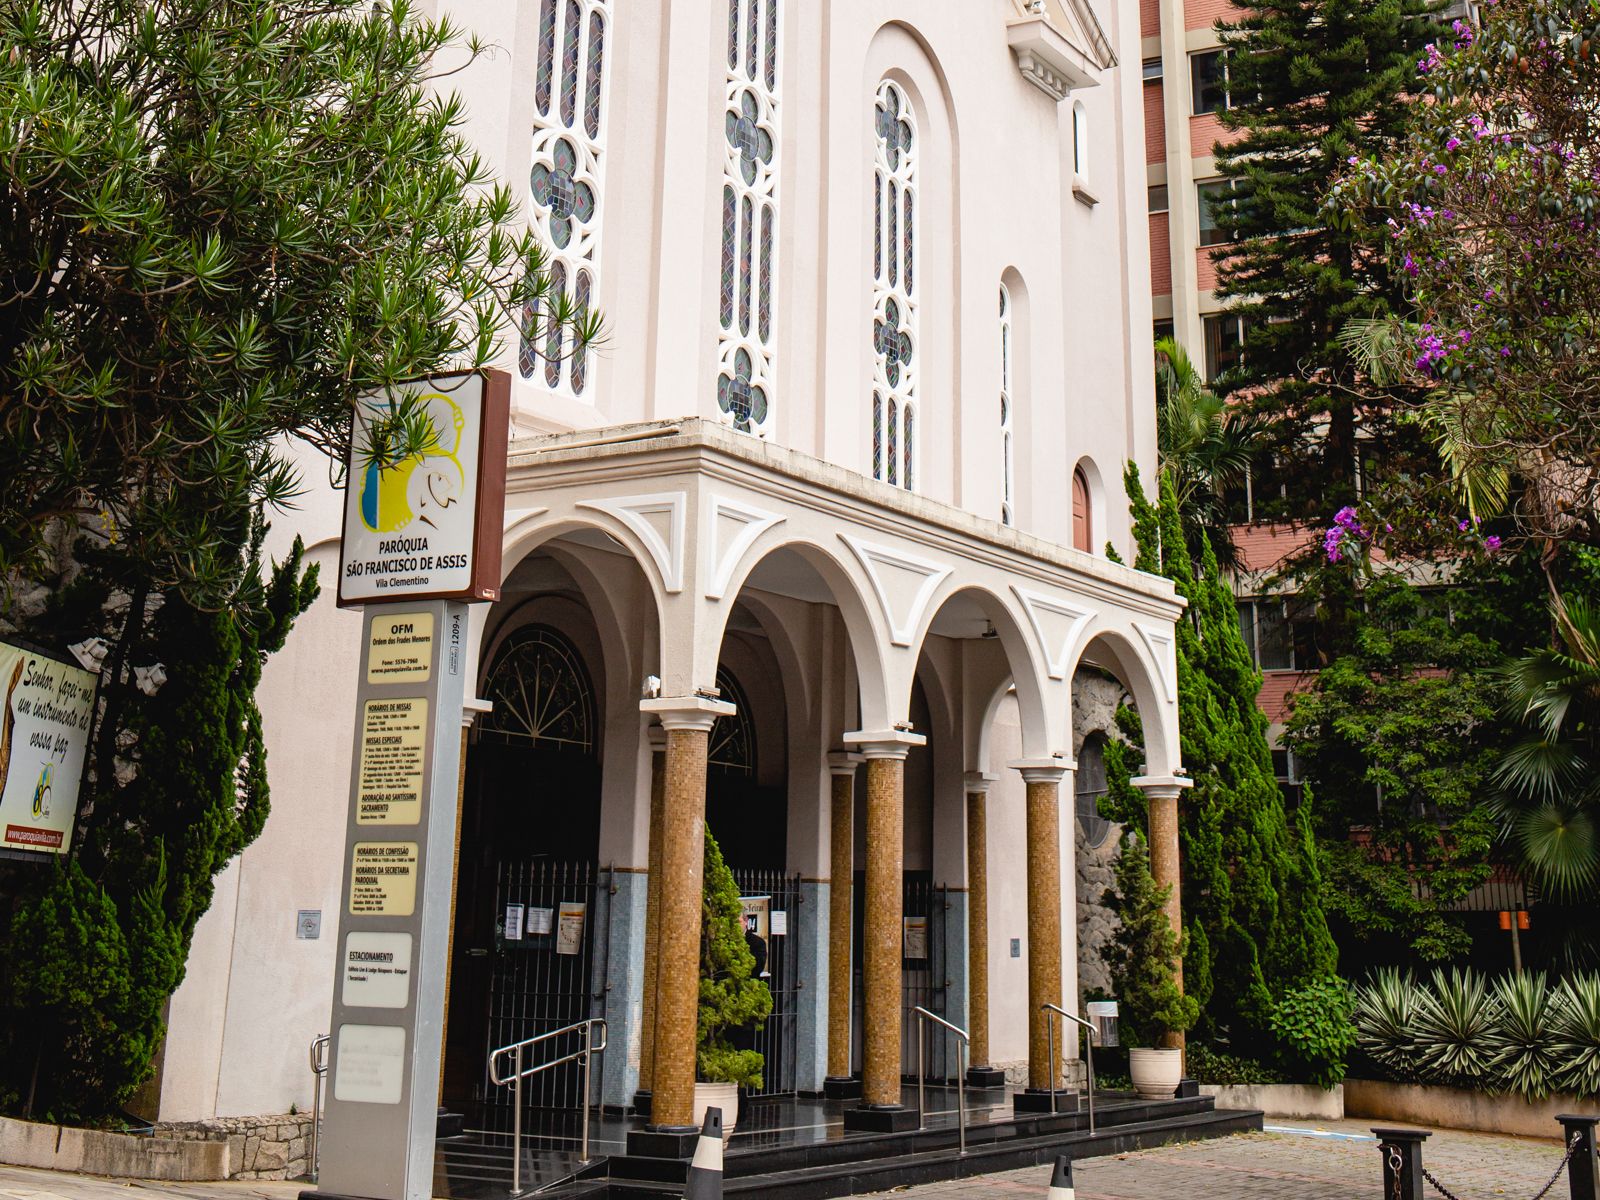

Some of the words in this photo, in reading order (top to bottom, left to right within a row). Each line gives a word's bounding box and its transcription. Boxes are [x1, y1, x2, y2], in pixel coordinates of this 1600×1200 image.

[379, 535, 428, 555] PARÓQUIA
[346, 560, 363, 577] SÃO
[365, 557, 417, 575] FRANCISCO
[420, 557, 433, 570] DE
[435, 554, 467, 569] ASSIS
[376, 579, 388, 588] Vila
[389, 576, 429, 587] Clementino
[391, 624, 413, 634] OFM
[452, 614, 461, 645] 1209-A
[372, 638, 387, 646] Ordem
[387, 637, 396, 645] dos
[396, 636, 411, 644] Frades
[23, 660, 54, 693] Senhor,
[368, 702, 389, 712] HORÁRIOS
[396, 703, 412, 711] MISSAS
[17, 698, 32, 715] um
[33, 697, 78, 728] instrumento
[78, 707, 89, 731] de
[366, 737, 381, 745] MISSAS
[29, 732, 52, 751] vossa
[51, 733, 69, 764] paz
[362, 792, 385, 802] ADORAÇÃO
[385, 793, 392, 801] AO
[361, 803, 389, 812] SACRAMENTO
[357, 845, 378, 855] HORÁRIOS
[385, 845, 409, 855] CONFISSÃO
[356, 864, 377, 874] HORÁRIOS
[349, 951, 393, 962] ESTACIONAMENTO
